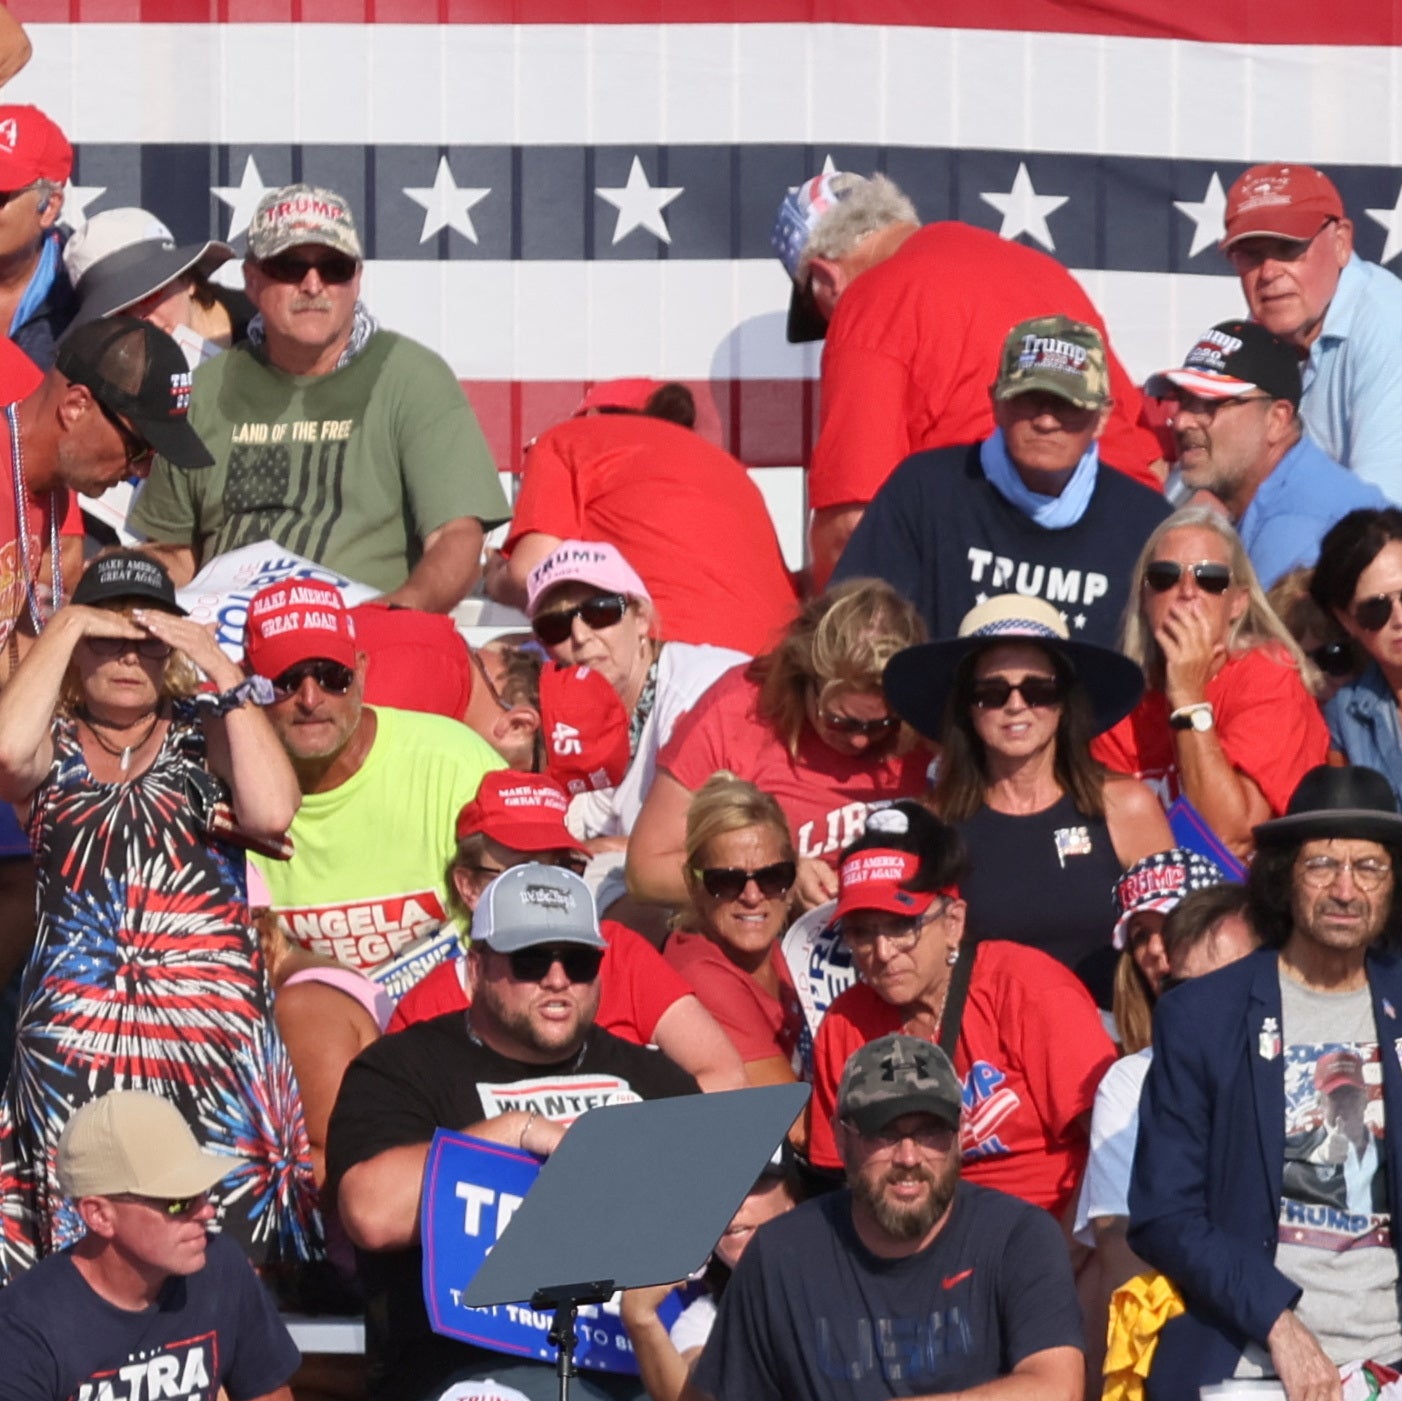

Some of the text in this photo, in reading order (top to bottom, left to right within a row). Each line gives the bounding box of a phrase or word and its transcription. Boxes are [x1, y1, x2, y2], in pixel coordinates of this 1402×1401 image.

[266, 200, 345, 221] TRUMP
[1022, 334, 1087, 365] Trump
[232, 418, 354, 444] LAND OF THE FREE
[534, 550, 607, 582] TRUMP
[967, 547, 1110, 607] TRUMP
[253, 587, 342, 616] MAKE AMERICA
[261, 613, 301, 639] GREAT
[552, 722, 583, 756] 45
[865, 856, 905, 869] AMERICA
[870, 869, 903, 880] AGAIN
[1282, 1197, 1369, 1233] TRUMP
[581, 1324, 609, 1347] TO
